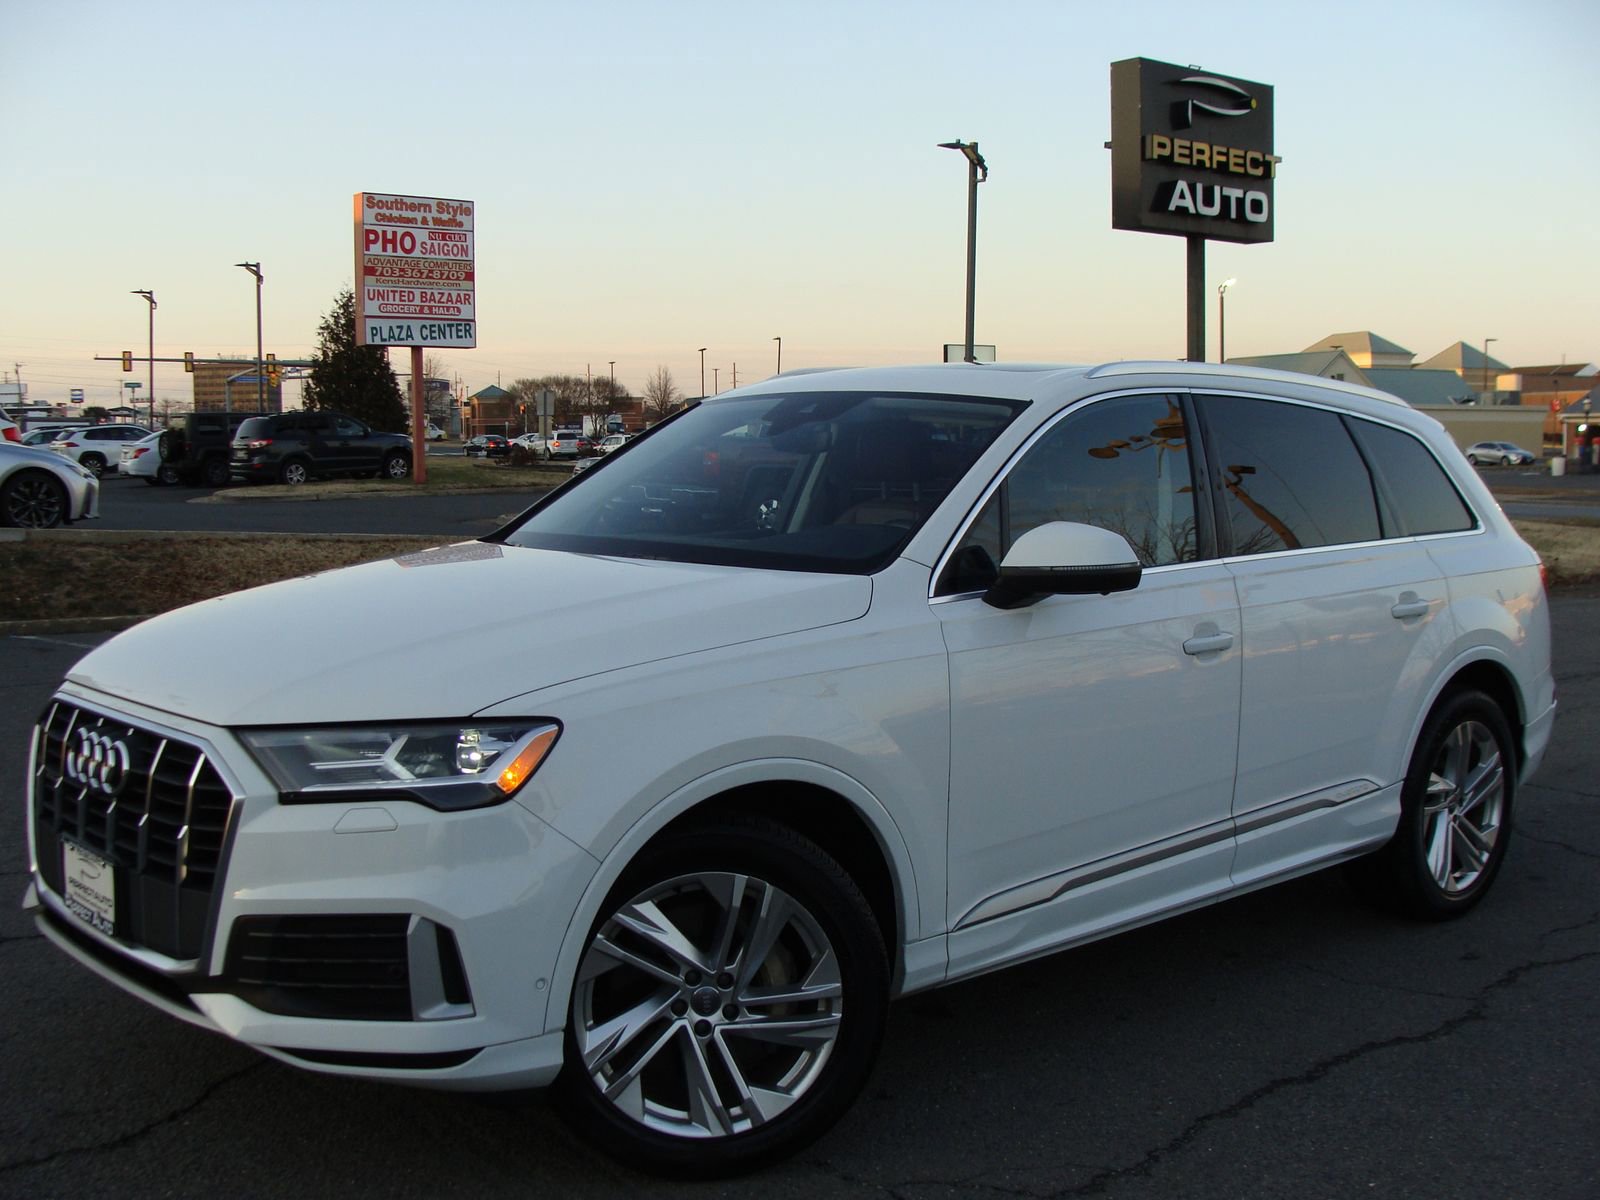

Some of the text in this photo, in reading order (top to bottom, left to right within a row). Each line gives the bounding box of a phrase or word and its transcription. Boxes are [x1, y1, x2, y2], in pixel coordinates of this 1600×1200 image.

[1151, 134, 1282, 178] PERFECT
[366, 196, 472, 218] Southern Style
[1168, 180, 1268, 223] AUTO
[375, 212, 418, 224] Chicken
[421, 216, 429, 226] &
[365, 229, 416, 254] PHO
[420, 242, 468, 257] SAIGON
[366, 258, 472, 271] ADVANTAGE COMPUTERS
[375, 267, 466, 280] 703-367-8709
[376, 278, 461, 288] KensHardware.com
[367, 288, 472, 305] UNITED BAZAAR
[380, 304, 420, 313] GROCERY
[432, 306, 460, 314] HALAL
[370, 323, 472, 342] PLAZA CENTER
